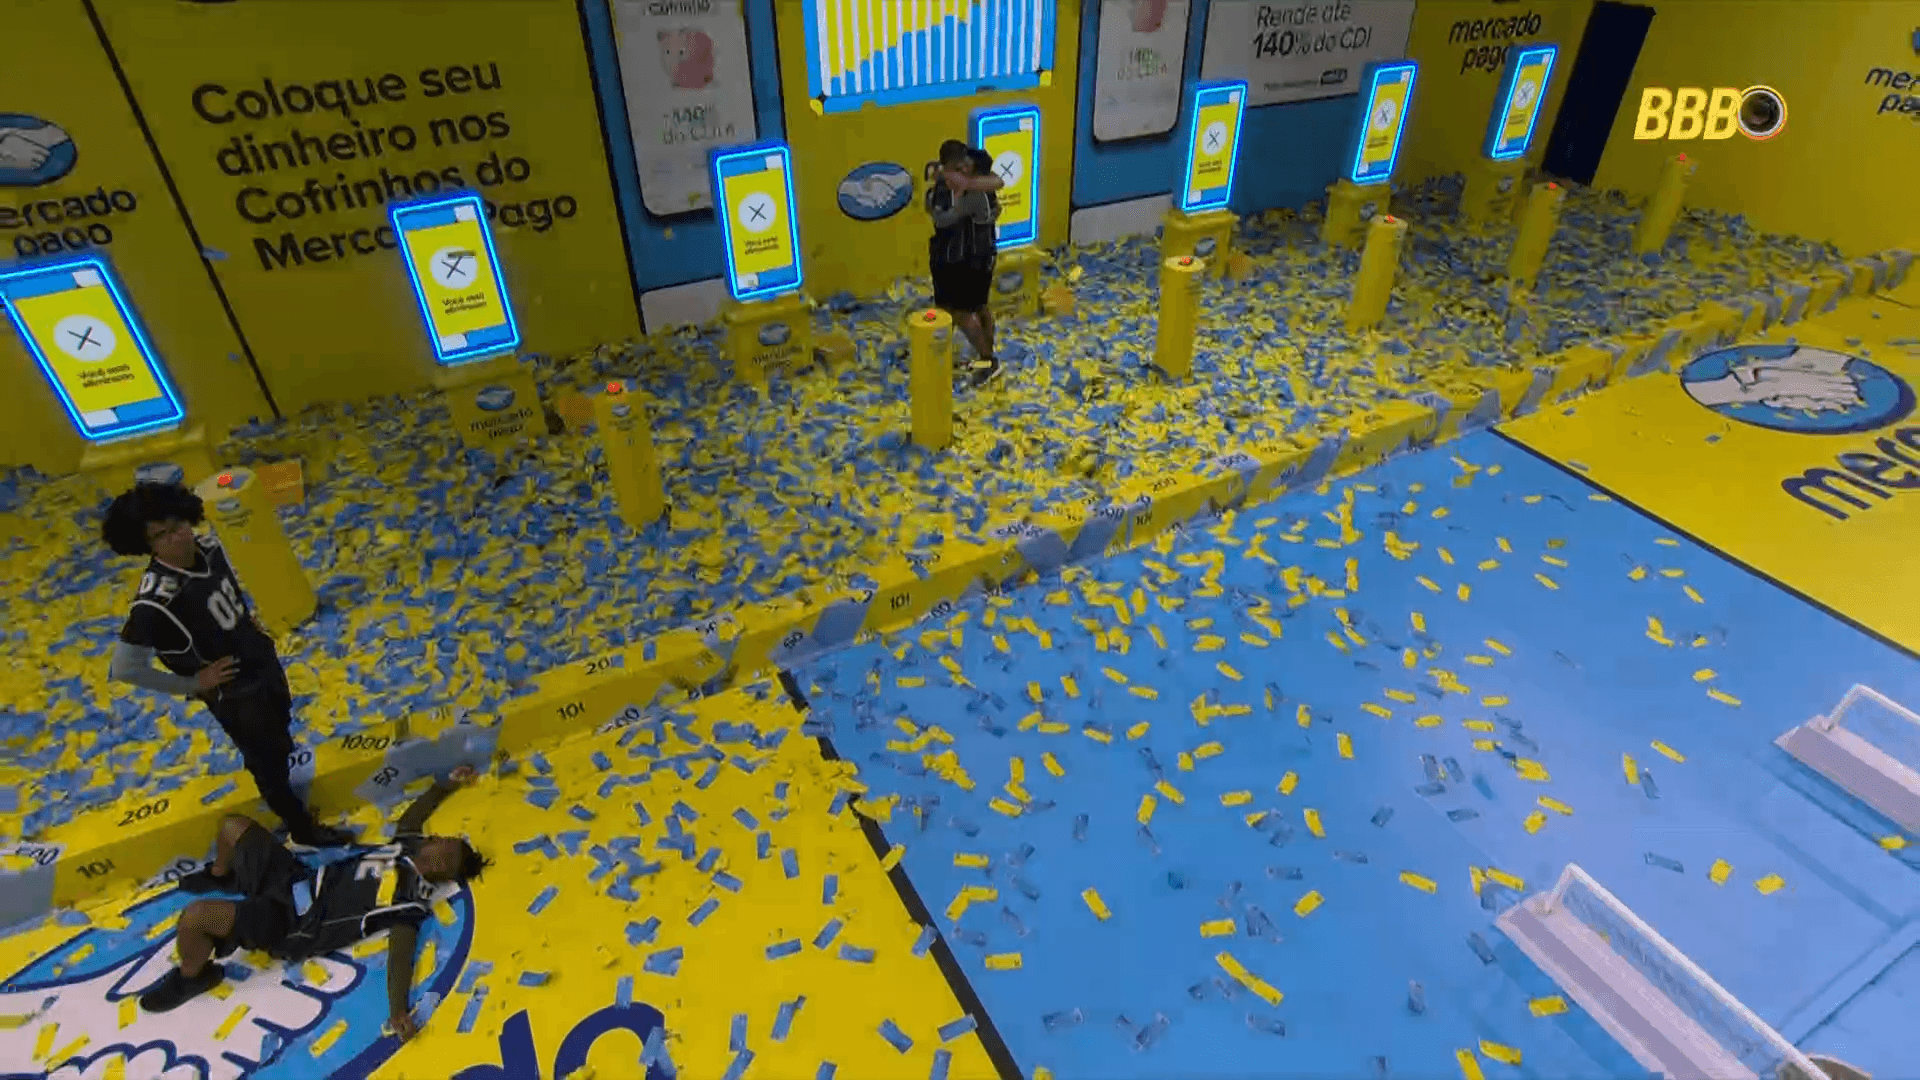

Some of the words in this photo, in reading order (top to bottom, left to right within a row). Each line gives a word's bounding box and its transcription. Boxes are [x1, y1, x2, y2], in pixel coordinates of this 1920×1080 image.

[1340, 26, 1373, 50] CDI
[1449, 9, 1542, 45] mercado
[192, 72, 407, 125] Coloque
[419, 61, 502, 98] seu
[216, 119, 417, 176] dinheiro
[427, 110, 511, 148] nos
[0, 186, 137, 229] ercado
[235, 166, 465, 224] Cofrinhos
[475, 152, 531, 187] do
[252, 223, 397, 271] Merc
[117, 798, 170, 828] 200
